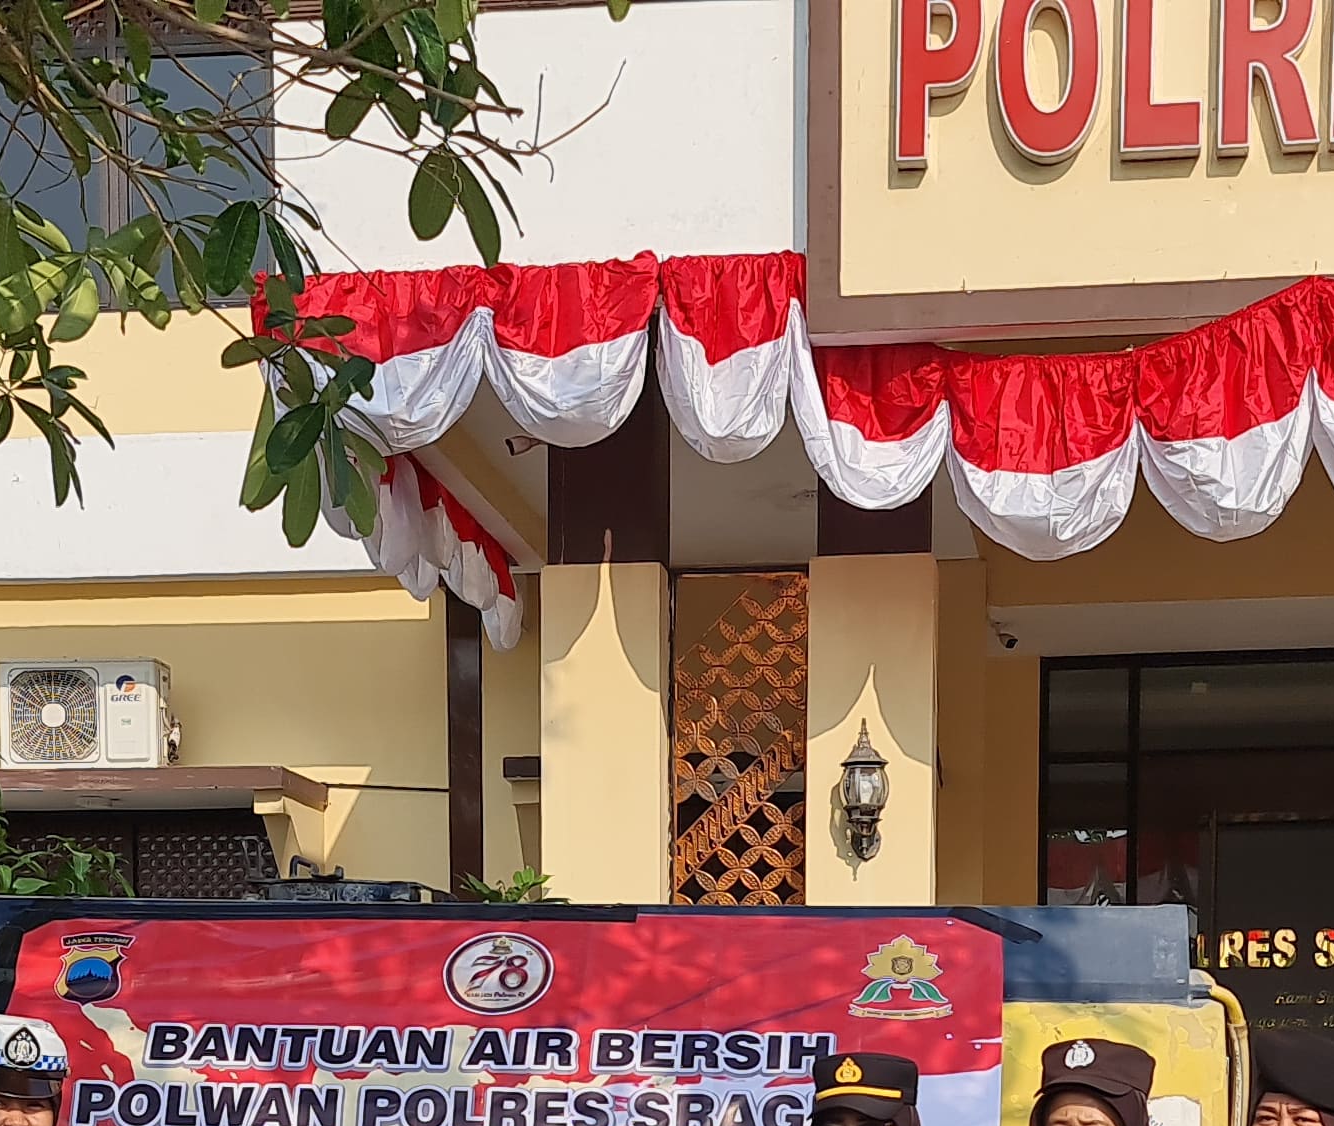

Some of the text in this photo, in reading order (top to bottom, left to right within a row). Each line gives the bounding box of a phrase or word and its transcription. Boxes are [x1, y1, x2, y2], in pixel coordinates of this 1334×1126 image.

[110, 693, 142, 702] GREE
[1196, 928, 1297, 968] LRES
[150, 1025, 832, 1071] BANTUAN AIR BERSIH
